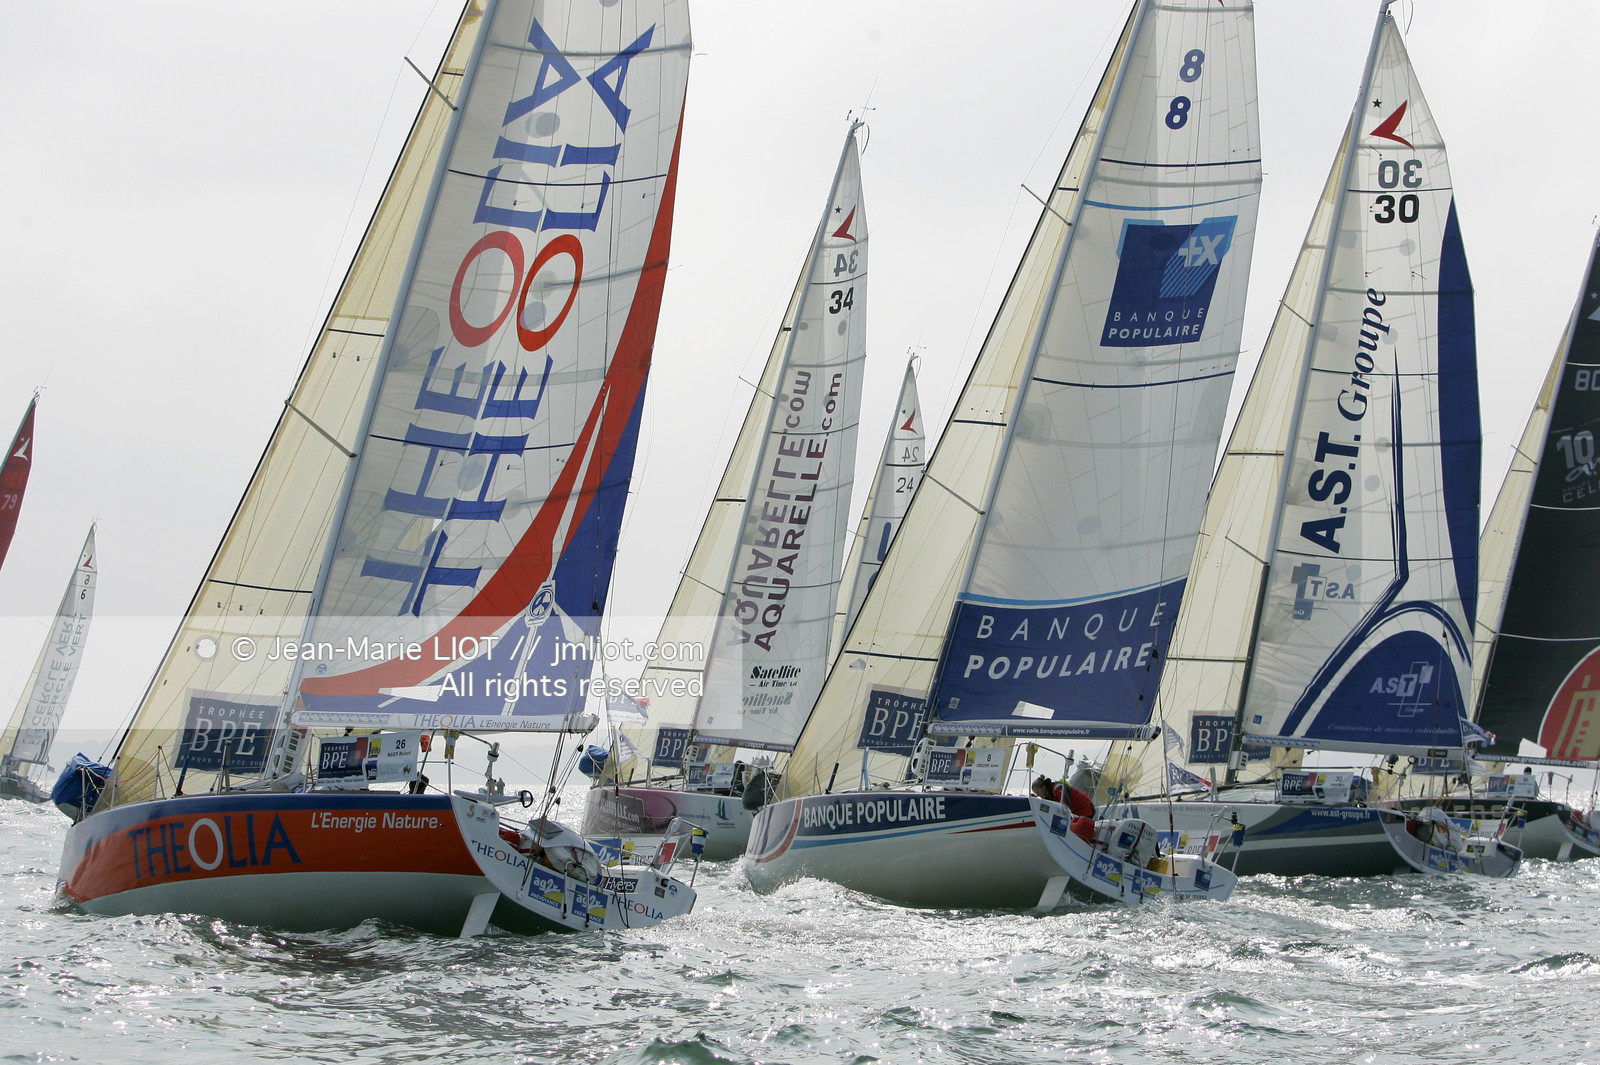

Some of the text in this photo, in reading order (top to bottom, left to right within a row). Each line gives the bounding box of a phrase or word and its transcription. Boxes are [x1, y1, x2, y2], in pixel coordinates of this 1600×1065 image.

[1165, 96, 1191, 130] 8
[1375, 194, 1420, 224] 30
[829, 287, 854, 315] 34
[411, 22, 656, 619] THEOLIA
[1113, 307, 1205, 322] BANQUE
[1108, 324, 1200, 339] POPULAIRE
[1337, 287, 1391, 422] Groupe
[896, 477, 914, 493] 24
[1, 493, 17, 511] 79
[754, 373, 842, 652] AQUARELLE.com
[80, 589, 87, 600] 6
[976, 602, 1167, 641] BANQUE
[42, 613, 87, 727] CERCLE VERT
[964, 642, 1153, 679] POPULAIRE
[750, 665, 802, 680] Satellite
[199, 705, 265, 720] TROPHÉE
[413, 714, 550, 730] THEOLIA L'Energie Nature
[189, 718, 262, 756] BPE
[395, 739, 406, 750] 26
[1197, 728, 1229, 752] BP
[322, 751, 349, 770] BPE
[930, 758, 952, 774] BPE
[986, 754, 992, 762] 8
[1283, 779, 1303, 791] BPE
[803, 796, 946, 831] BANQUE POPULAIRE
[1310, 808, 1371, 822] www.ast-groupe.fr
[127, 812, 438, 880] THEOLIA L'Energie Nature
[470, 839, 528, 872] THEOLIA
[533, 876, 561, 894] ag2r
[605, 876, 637, 893] Hyères
[609, 893, 664, 921] THEOLIA
